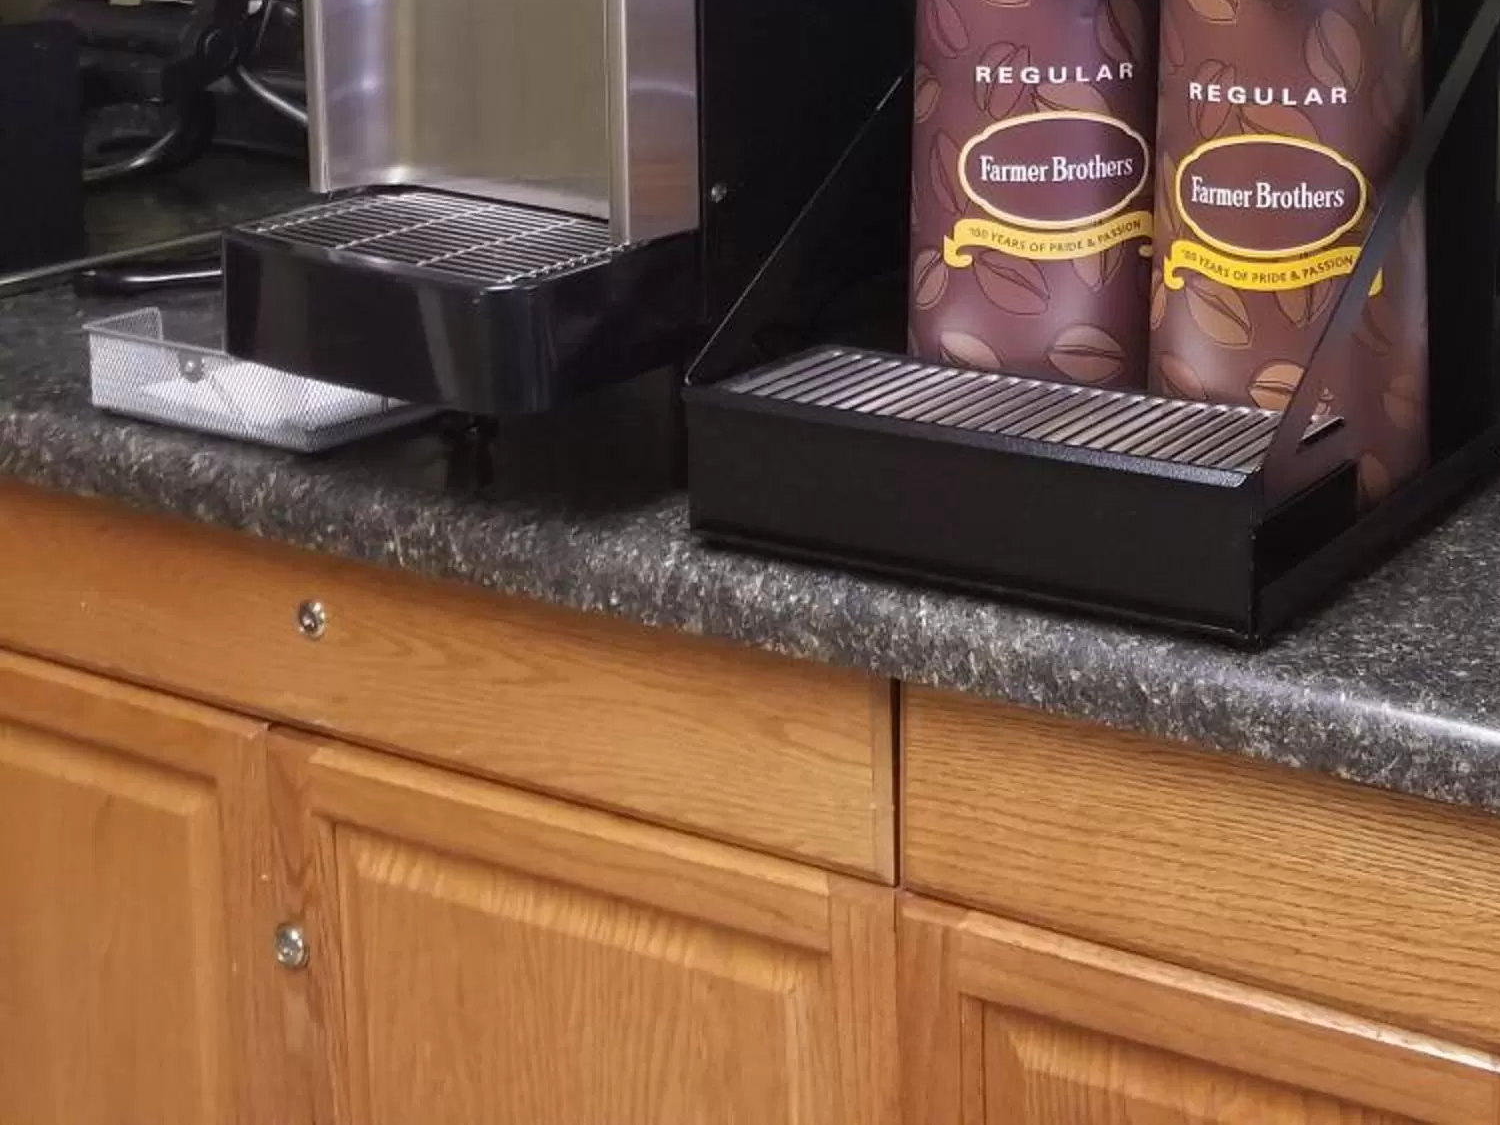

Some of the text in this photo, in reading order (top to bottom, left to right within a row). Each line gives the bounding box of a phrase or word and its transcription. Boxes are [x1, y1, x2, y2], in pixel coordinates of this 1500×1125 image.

[975, 62, 1134, 84] REGULAR
[1188, 82, 1348, 106] REGULAR
[979, 153, 1134, 183] Farmer Brothers
[1190, 175, 1345, 210] Farmer Brothers
[990, 231, 1026, 251] YEARS
[1029, 241, 1046, 253] OF
[1049, 241, 1083, 253] PRIDE
[1087, 237, 1096, 248] &
[1097, 219, 1142, 243] PASSION
[1199, 254, 1230, 278] YEARS
[1233, 270, 1249, 282] OF
[1251, 271, 1288, 284] PRIDE
[1291, 270, 1302, 282] &
[1302, 254, 1354, 280] PASSION
